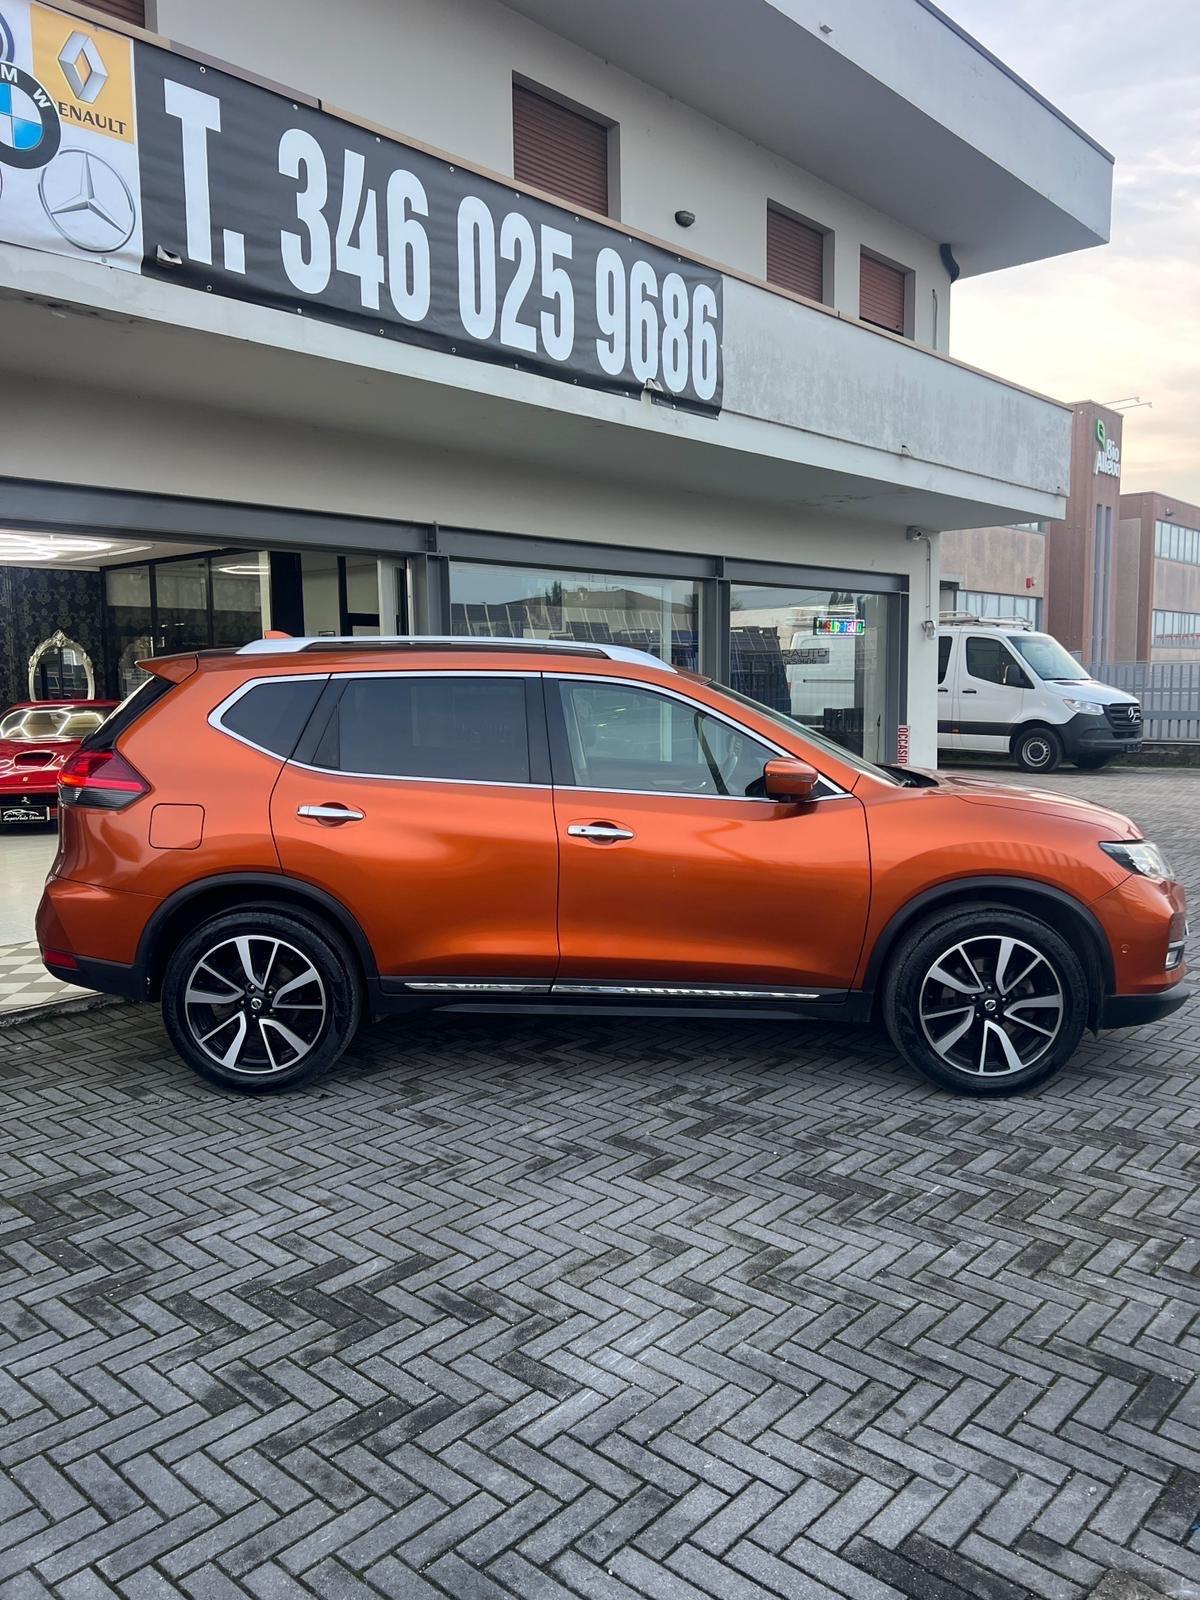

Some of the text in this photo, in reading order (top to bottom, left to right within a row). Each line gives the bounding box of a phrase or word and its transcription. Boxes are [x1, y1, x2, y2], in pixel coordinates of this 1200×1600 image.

[55, 101, 126, 135] ENAULT
[163, 78, 718, 400] T. 346 025 9686
[1106, 439, 1120, 462] Bio
